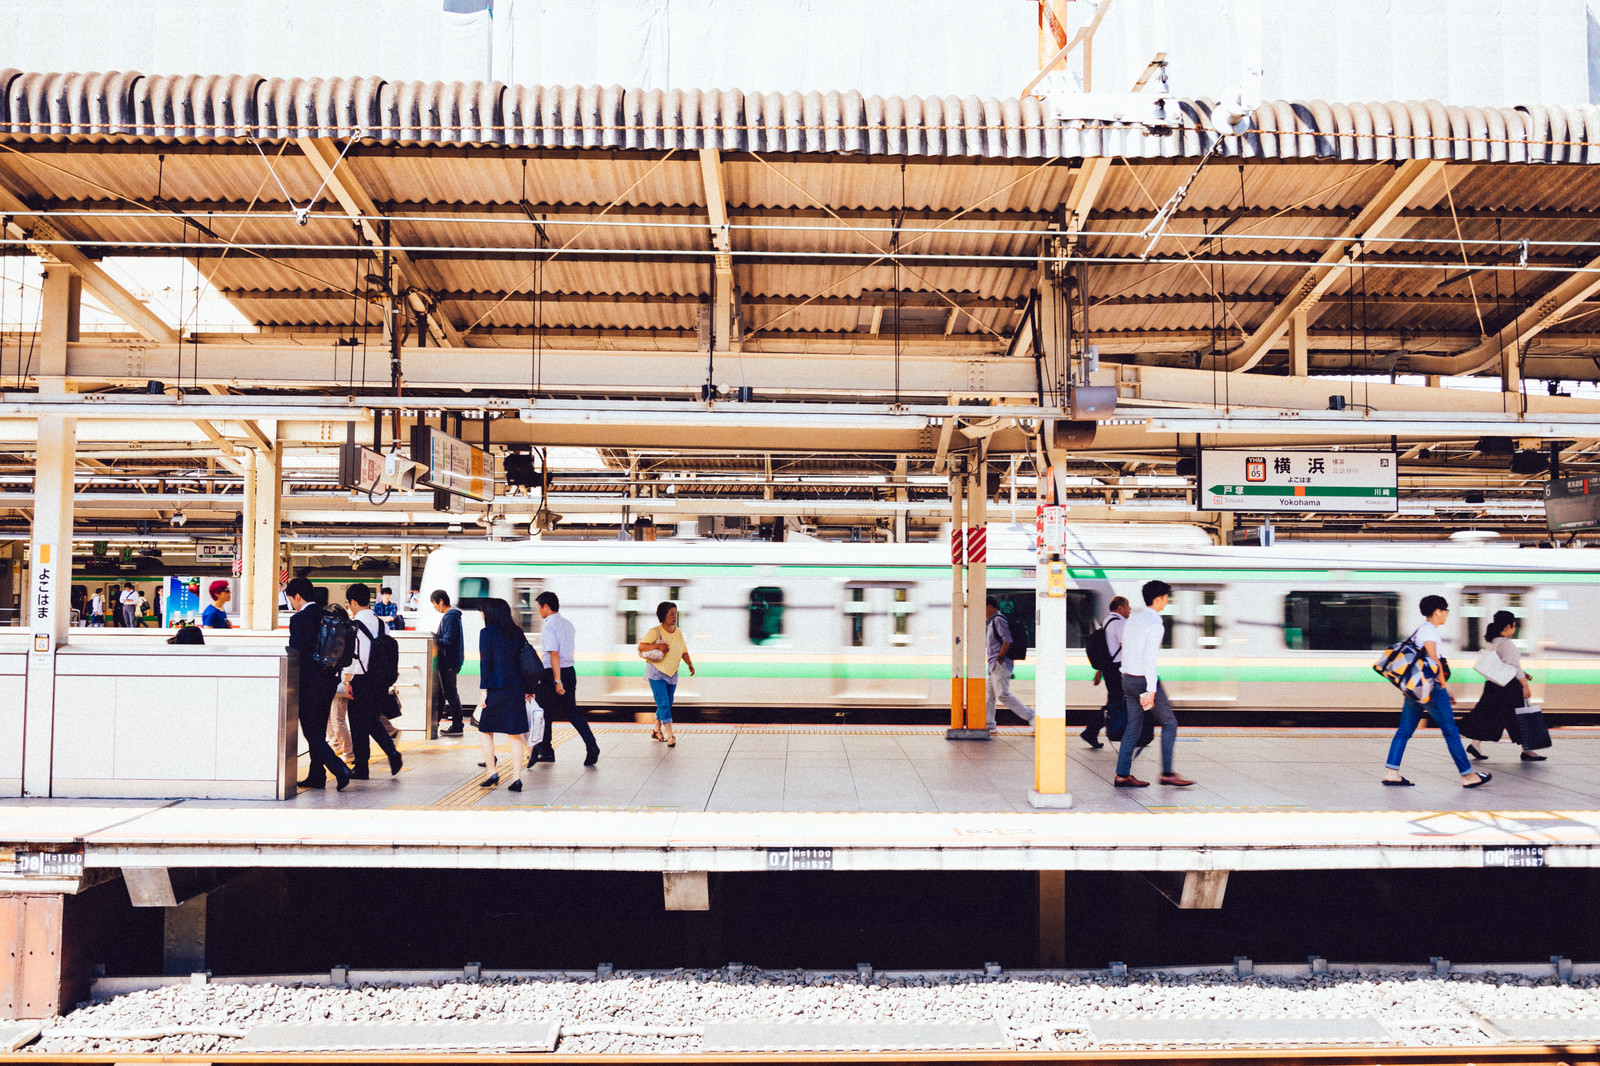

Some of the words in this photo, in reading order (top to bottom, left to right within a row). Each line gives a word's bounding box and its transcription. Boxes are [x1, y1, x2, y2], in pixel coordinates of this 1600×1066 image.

[1274, 457, 1325, 474] 横浜
[1545, 484, 1551, 496] 6
[1279, 498, 1321, 506] Yokohama
[38, 568, 50, 619] よこはま
[768, 852, 788, 867] 07
[794, 861, 831, 869] D=1527
